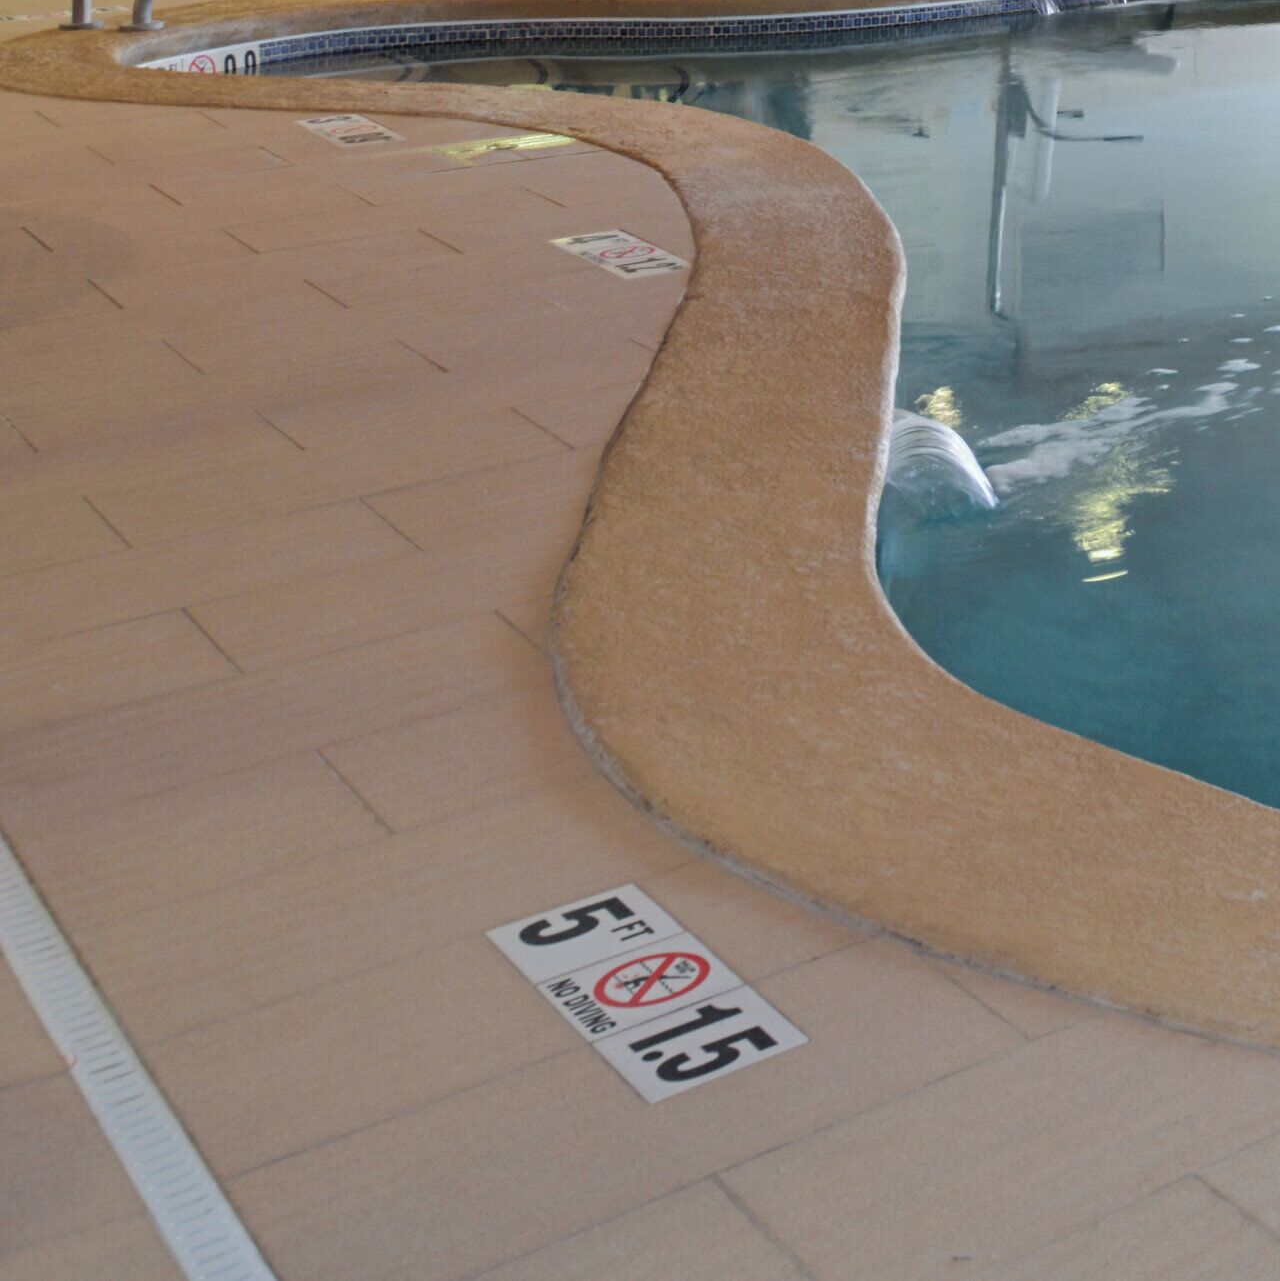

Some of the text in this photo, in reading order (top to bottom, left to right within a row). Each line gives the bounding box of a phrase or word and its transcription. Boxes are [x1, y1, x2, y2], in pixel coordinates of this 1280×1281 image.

[518, 896, 779, 1084] 5 FT 1.5
[547, 977, 618, 1035] NO DIVING
